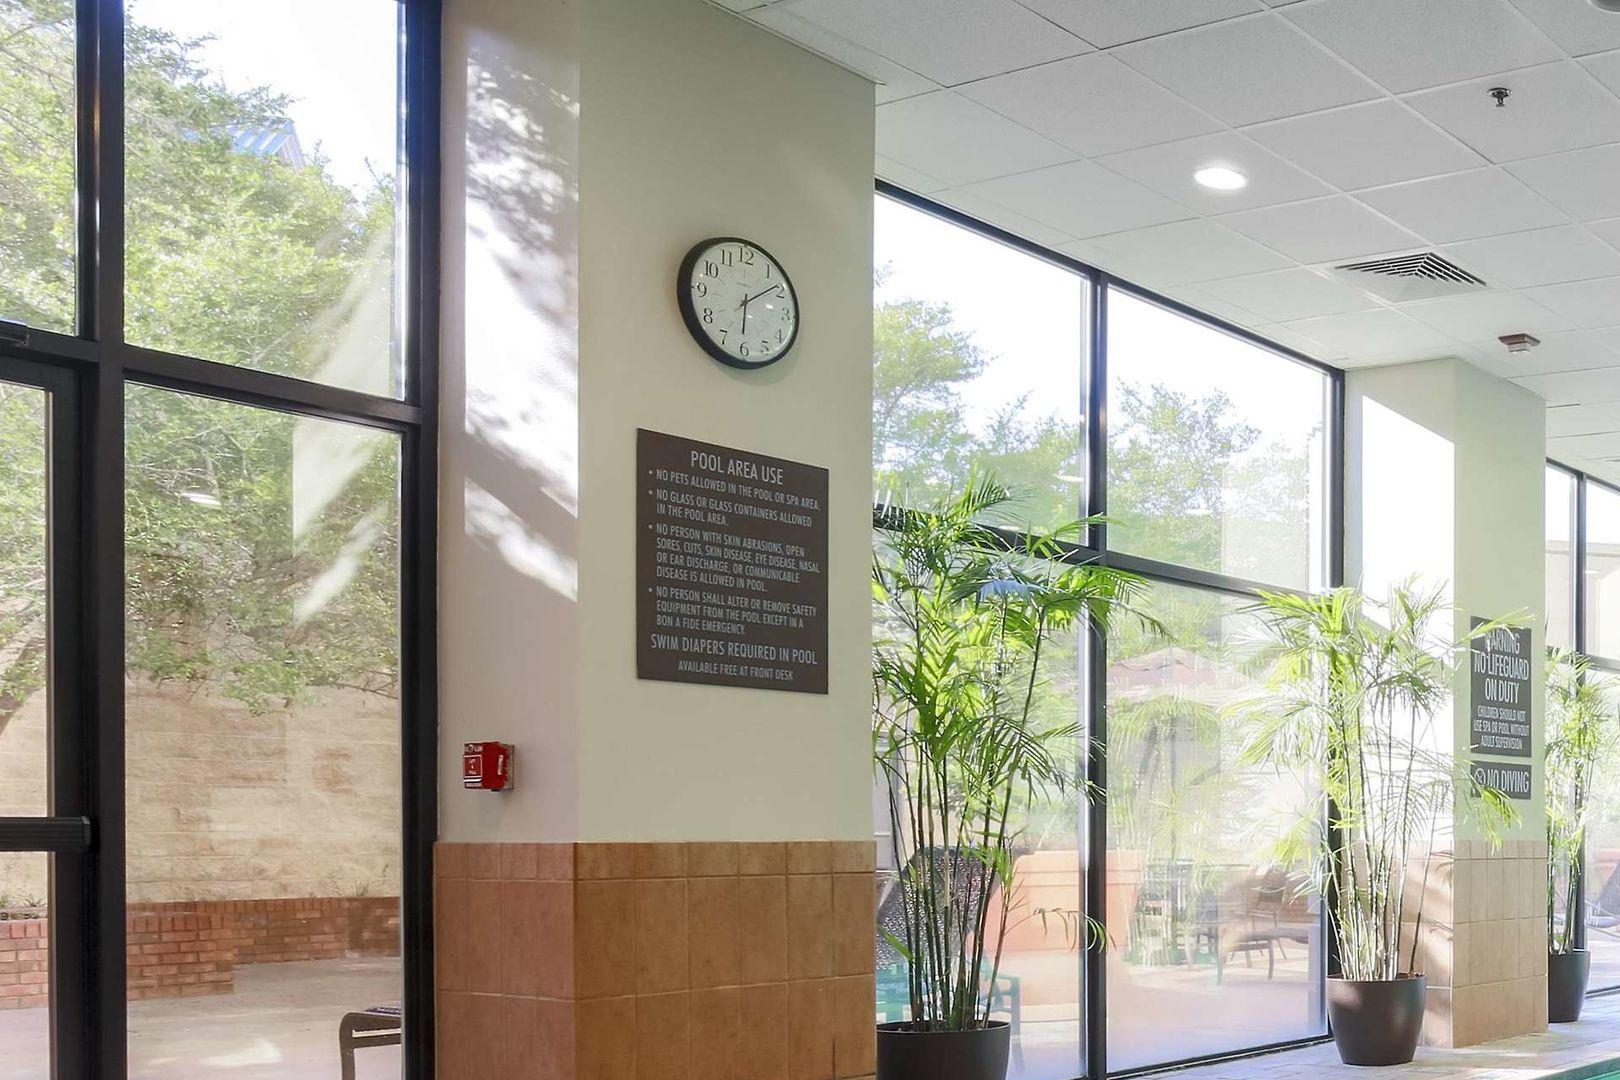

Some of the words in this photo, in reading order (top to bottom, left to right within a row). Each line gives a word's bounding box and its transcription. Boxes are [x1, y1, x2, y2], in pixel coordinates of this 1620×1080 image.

[721, 249, 732, 267] 11
[739, 248, 754, 265] 12
[705, 261, 718, 278] 10
[766, 264, 769, 278] 1
[697, 283, 707, 297] 9
[776, 283, 784, 298] 2
[704, 308, 713, 324] 8
[782, 308, 790, 322] 3
[720, 329, 727, 344] 7
[775, 329, 782, 343] 4
[740, 342, 749, 356] 6
[761, 340, 769, 355] 5
[691, 451, 724, 473] POOL
[728, 459, 758, 480] AREA
[762, 467, 783, 485] USE
[657, 469, 668, 480] NO
[671, 472, 688, 485] PETS
[691, 476, 726, 491] ALLOWED
[728, 484, 736, 494] IN
[739, 484, 751, 497] THE
[754, 489, 772, 501] POOL
[775, 492, 784, 503] OR
[787, 494, 799, 506] SPA
[657, 490, 668, 500] NO
[671, 492, 694, 505] GLASS
[697, 497, 707, 507] OR
[709, 499, 732, 513] GLASS
[735, 503, 778, 521] CONTAINERS
[780, 513, 811, 527] ALLOWED
[657, 503, 665, 514] IN
[668, 505, 682, 517] THE
[685, 508, 705, 521] POOL
[708, 513, 728, 526] AREA.
[657, 524, 668, 535] NO
[671, 527, 700, 540] PERSON
[703, 532, 722, 543] WITH
[724, 535, 740, 547] SKIN
[786, 546, 805, 557] OPEN
[657, 552, 667, 562] OR
[670, 554, 684, 565] EAR
[733, 564, 743, 575] OR
[746, 566, 799, 583] COMMUNICABLE
[705, 545, 722, 558] SKIN
[756, 554, 767, 566] EYE
[800, 562, 820, 573] NASAL
[657, 567, 688, 580] DISEASE
[690, 571, 697, 582] IS
[700, 573, 734, 587] ALLOWED
[737, 578, 744, 588] IN
[746, 579, 767, 592] POOL.
[657, 587, 668, 597] NO
[670, 589, 700, 602] PERSON
[703, 593, 725, 605] SHALL
[728, 597, 748, 609] ALTER
[751, 600, 760, 610] OR
[763, 602, 790, 613] REMOVE
[792, 605, 817, 617] SAFETY
[656, 615, 672, 627] BON
[675, 617, 680, 627] A
[683, 618, 700, 630] FIDE
[657, 601, 701, 616] EQUIPMENT
[703, 607, 724, 619] FROM
[726, 610, 740, 621] THE
[742, 612, 760, 623] POOL
[763, 614, 787, 627] EXCEPT
[789, 618, 796, 627] IN
[799, 619, 803, 628] A
[652, 634, 679, 650] SWIM
[683, 637, 724, 655] DIAPERS
[728, 643, 776, 660] REQUIRED
[779, 649, 789, 662] IN
[792, 650, 817, 665] POOL
[679, 661, 718, 674] AVAILABLE
[720, 665, 737, 676] FREE
[739, 667, 748, 676] AT
[751, 668, 774, 679] FRONT
[776, 671, 793, 681] DESK
[1474, 653, 1486, 673] NO
[1488, 656, 1529, 680] LIFEGUARD
[1485, 678, 1497, 700] ON
[1499, 681, 1520, 704] DUTY
[1487, 769, 1499, 788] NO
[1501, 770, 1529, 793] DIVING
